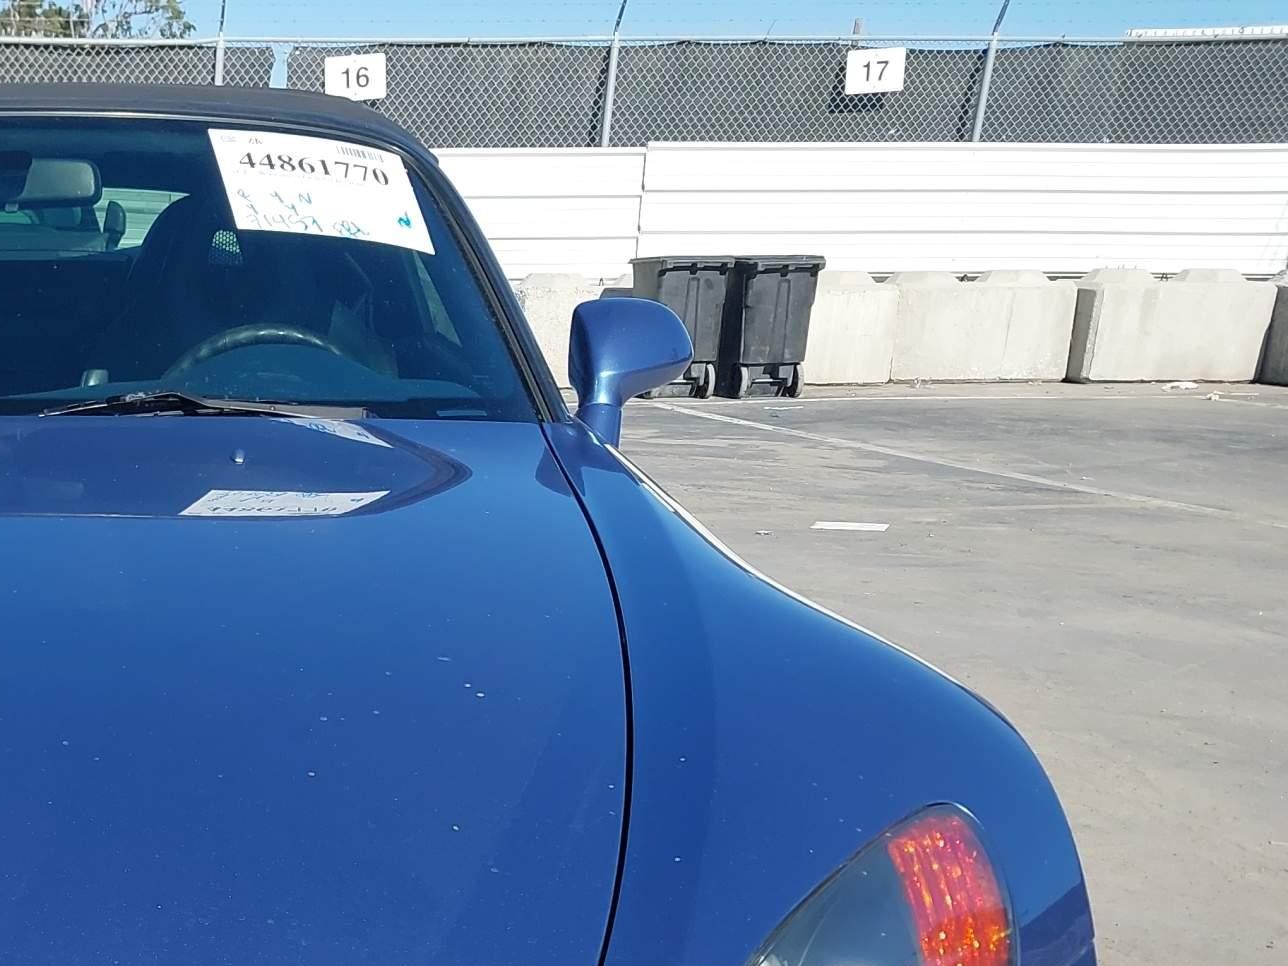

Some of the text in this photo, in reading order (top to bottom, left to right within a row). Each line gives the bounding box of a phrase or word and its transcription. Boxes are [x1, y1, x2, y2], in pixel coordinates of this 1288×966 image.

[341, 66, 370, 89] 16
[862, 60, 889, 82] 17
[239, 151, 390, 186] 44861770
